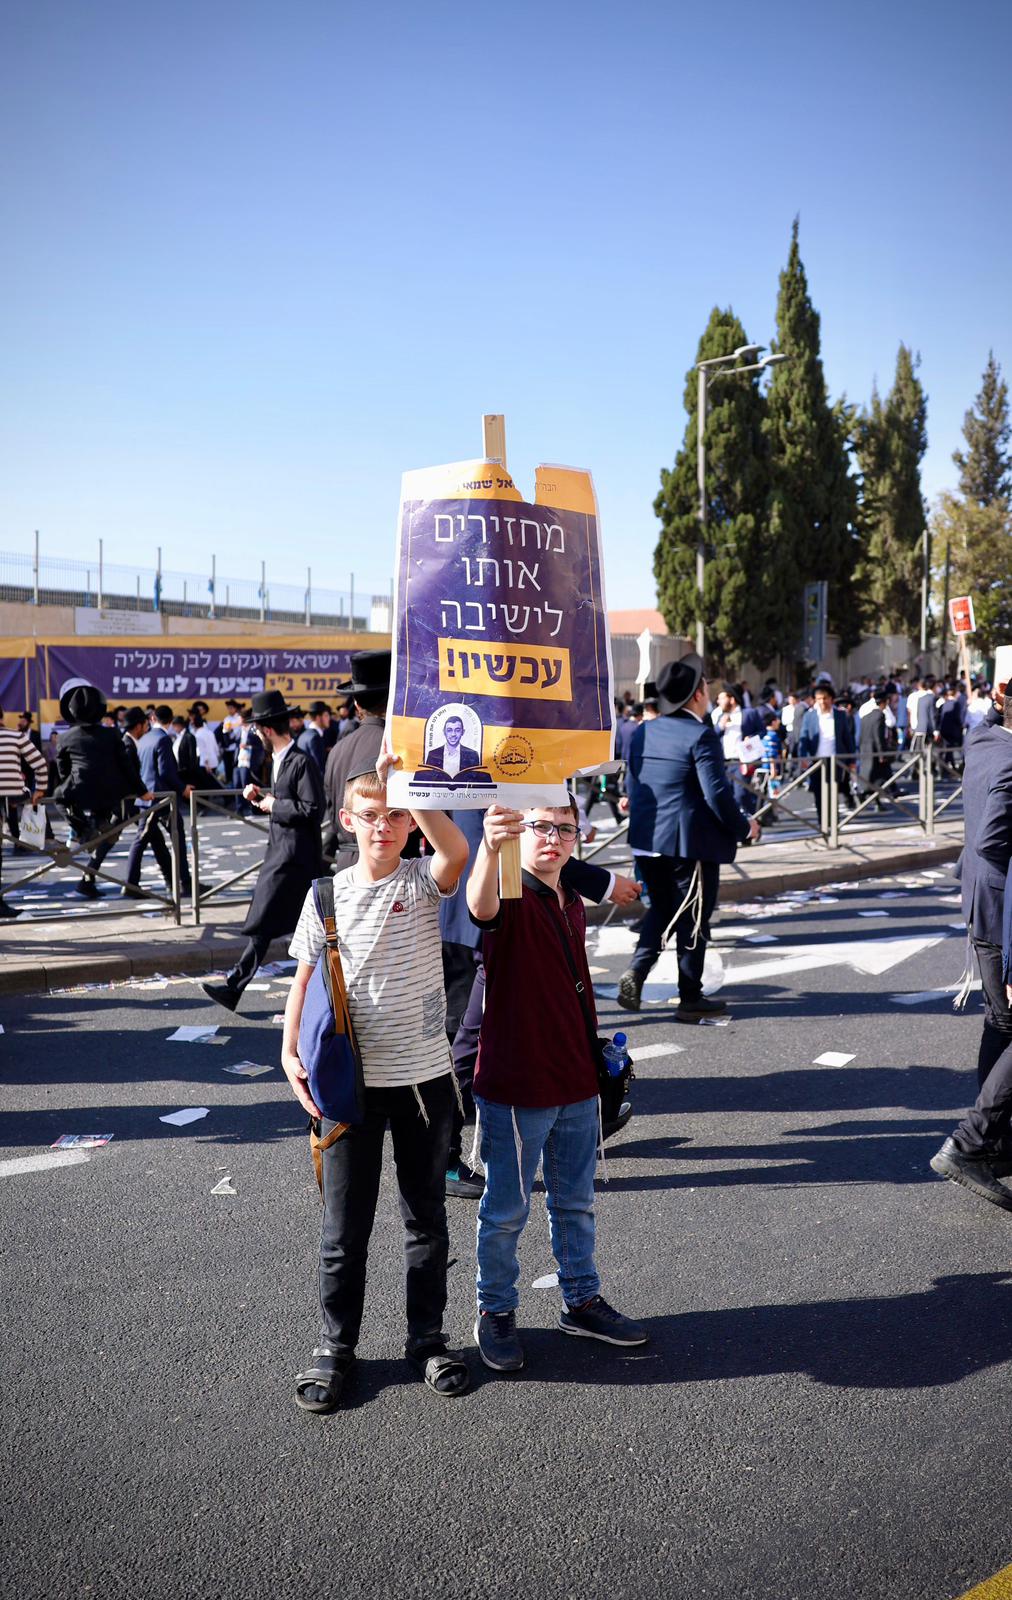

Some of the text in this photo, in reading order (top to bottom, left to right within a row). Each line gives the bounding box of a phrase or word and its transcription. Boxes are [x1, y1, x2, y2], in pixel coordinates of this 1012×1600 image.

[463, 480, 492, 490] שמאי
[434, 514, 564, 553] מחזירים
[462, 557, 542, 592] אותו
[440, 600, 564, 637] לישיבה
[114, 650, 174, 670] העליה
[182, 652, 212, 672] לבן
[219, 654, 277, 672] זועקים
[283, 652, 338, 668] ישראל
[446, 648, 562, 688] עכשיו!
[112, 676, 151, 693] צר!
[156, 674, 189, 693] לנו
[194, 677, 264, 696] בצערך
